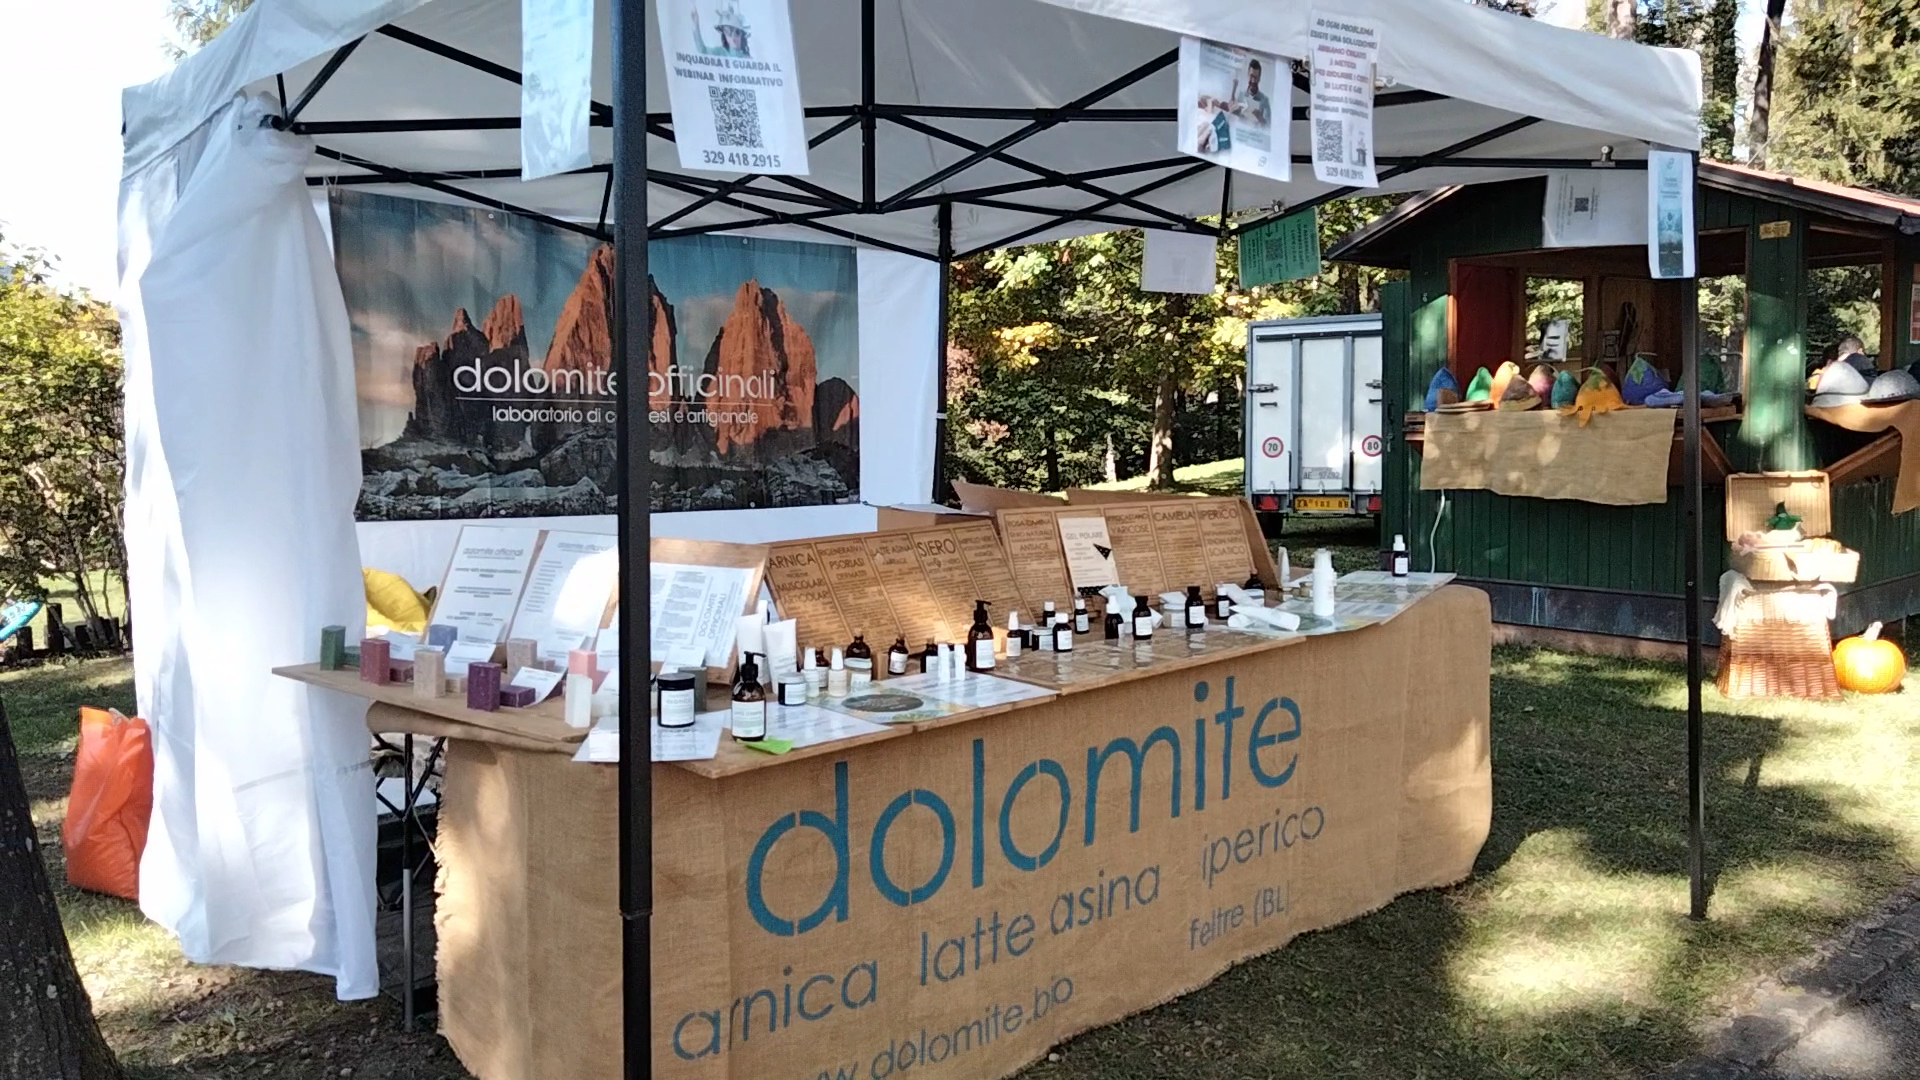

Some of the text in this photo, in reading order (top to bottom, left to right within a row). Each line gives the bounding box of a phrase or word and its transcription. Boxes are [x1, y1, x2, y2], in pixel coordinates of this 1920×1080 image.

[675, 52, 782, 72] INQUADRA E GUARDA IL
[674, 66, 784, 87] WEBINAR INFORMATIVO
[703, 150, 781, 168] 329 418 2915
[453, 358, 617, 395] dolomite
[493, 405, 583, 423] laboratorio
[587, 407, 601, 423] di
[674, 411, 684, 423] e
[686, 409, 759, 427] artigianale
[1267, 442, 1278, 452] 70
[1367, 441, 1379, 451] 80
[916, 538, 956, 557] SIERO
[769, 553, 817, 569] ARNICA
[745, 675, 1301, 937] dolomite
[672, 806, 1324, 1061] arnica latte asina iperico
[1190, 904, 1244, 951] feltre
